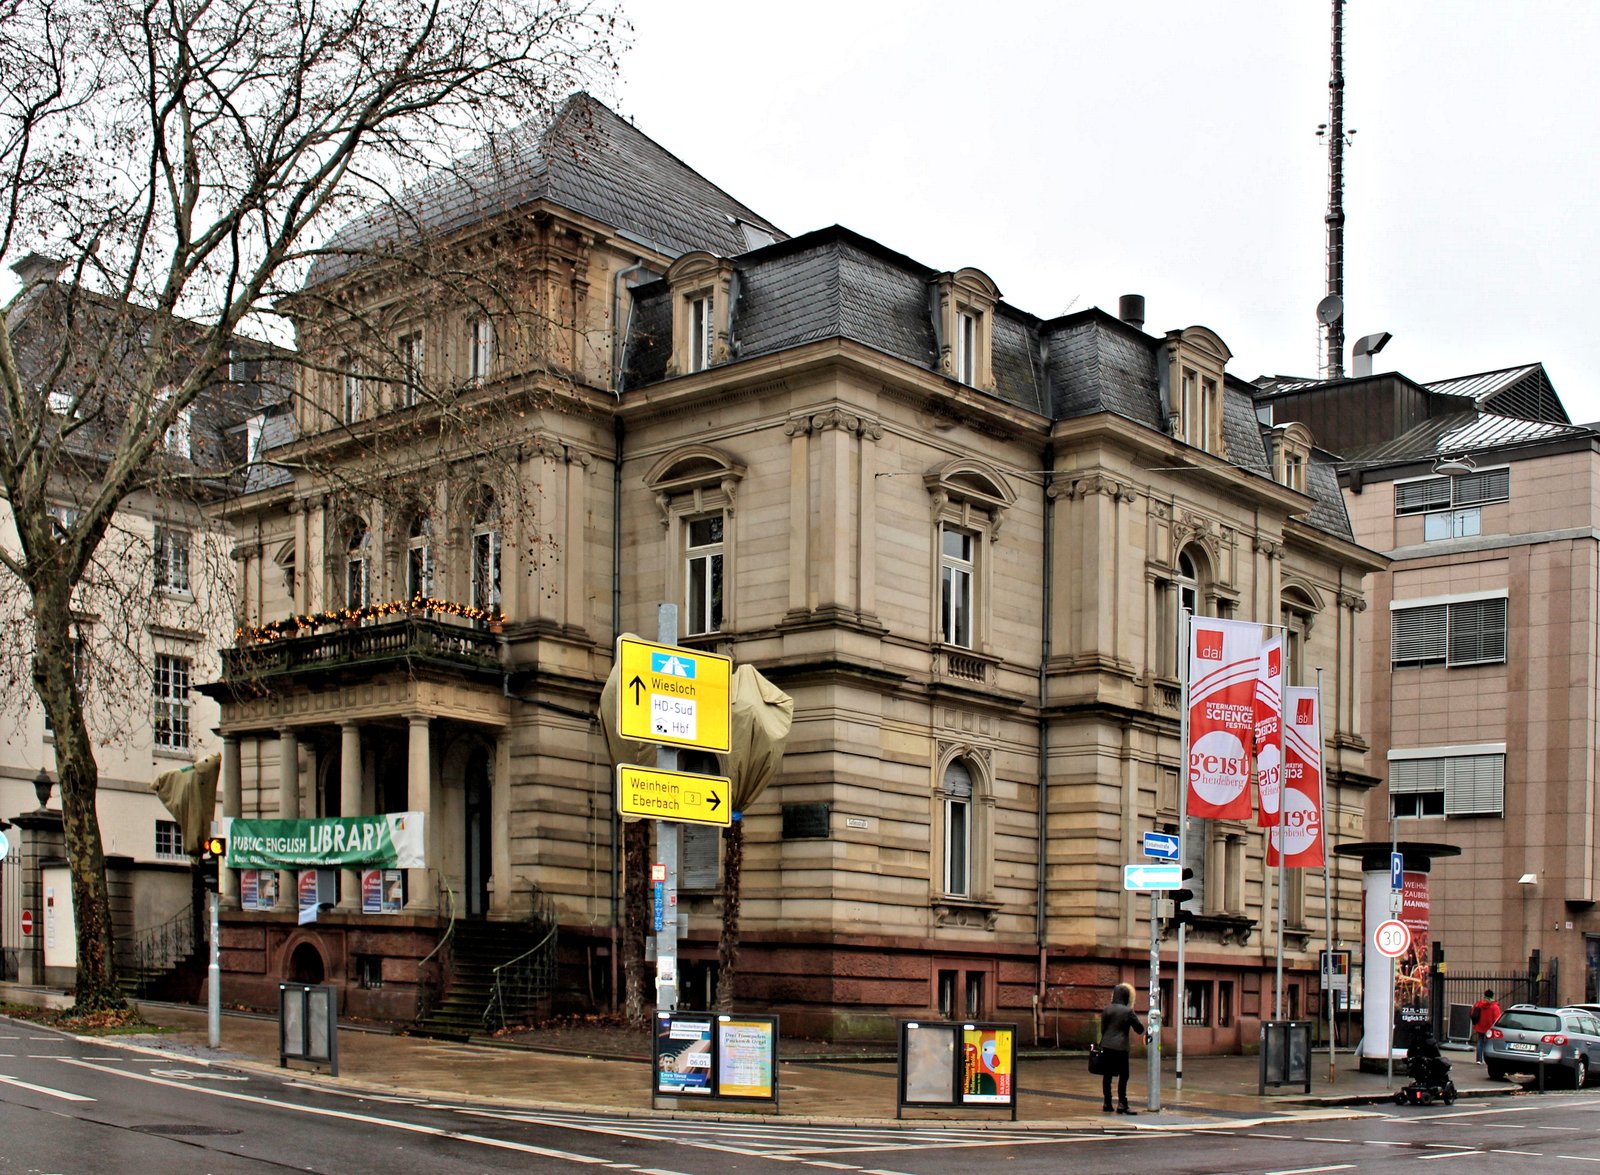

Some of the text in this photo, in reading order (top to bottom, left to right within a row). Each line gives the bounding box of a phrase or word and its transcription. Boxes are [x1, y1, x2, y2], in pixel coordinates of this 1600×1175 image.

[1202, 645, 1222, 660] dai
[651, 677, 696, 696] Wiesloch
[654, 699, 693, 716] HD-Süd
[1206, 708, 1253, 723] SCIENCE
[672, 722, 689, 734] Hbf
[1189, 753, 1249, 782] geist
[630, 777, 695, 803] Weinheim 3
[1202, 773, 1244, 790] heidelberg
[632, 793, 680, 811] Eberbach
[233, 823, 386, 853] PUBLIC ENGLISH LIBRARY
[1394, 857, 1401, 885] P
[1383, 931, 1401, 946] 30
